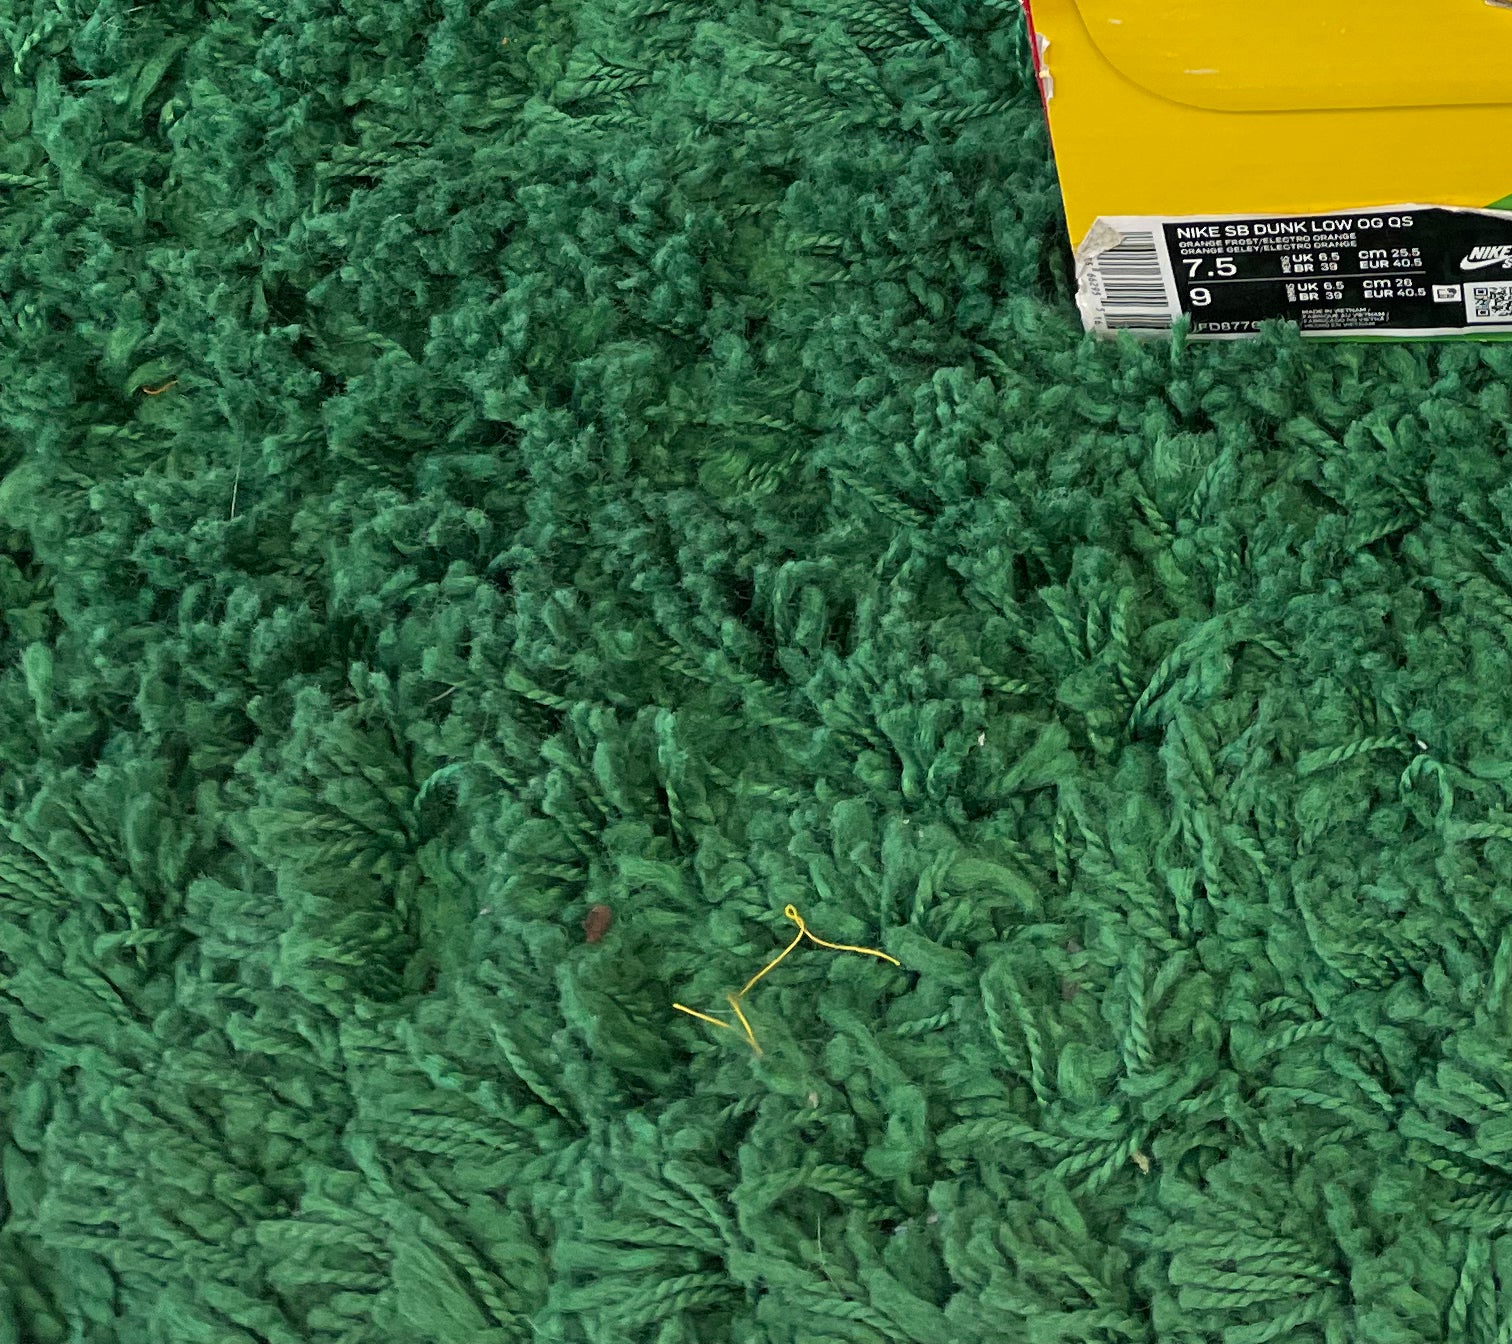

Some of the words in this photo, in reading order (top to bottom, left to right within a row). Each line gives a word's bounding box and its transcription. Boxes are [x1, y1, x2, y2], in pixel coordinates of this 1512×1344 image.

[1177, 226, 1221, 239] NIKE
[1224, 224, 1249, 237] SB
[1253, 221, 1307, 235] DUNK
[1312, 219, 1353, 232] LOW
[1357, 217, 1384, 229] OG
[1388, 216, 1414, 228] QS
[1179, 239, 1222, 248] ORANGE
[1313, 232, 1357, 242] ORANGE
[1180, 246, 1223, 255] ORANGE
[1314, 240, 1357, 249] ORANGE
[1292, 253, 1314, 262] UK
[1318, 251, 1340, 261] 6.5
[1358, 249, 1387, 259] cm
[1391, 247, 1421, 257] 25.5
[1469, 244, 1512, 260] NIKE
[1182, 256, 1238, 278] 7.5
[1293, 263, 1314, 273] BR
[1360, 259, 1390, 269] EUR
[1393, 257, 1423, 267] 40.5
[1297, 282, 1319, 291] UK
[1323, 280, 1345, 290] 6.5
[1363, 279, 1392, 288] cm
[1189, 287, 1212, 307] 9
[1299, 292, 1319, 301] BR
[1325, 291, 1343, 300] 39
[1364, 289, 1394, 299] EUR
[1397, 287, 1427, 297] 40.5
